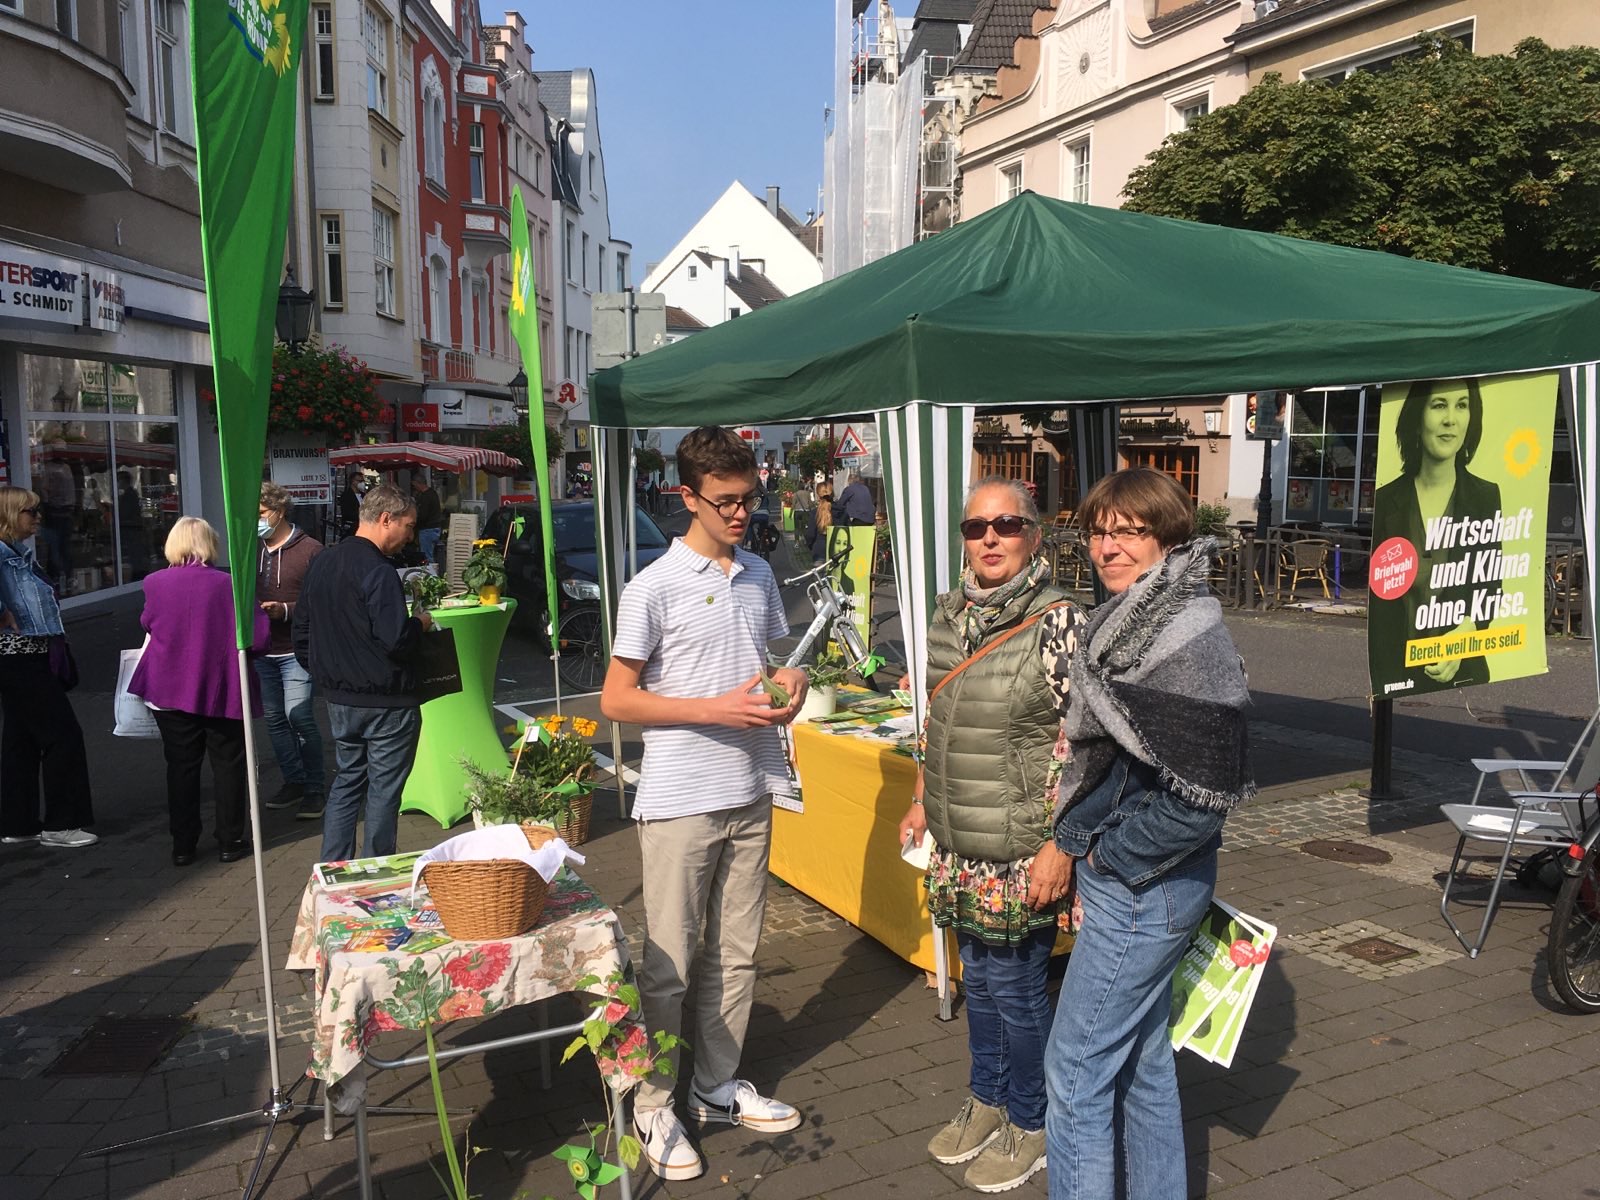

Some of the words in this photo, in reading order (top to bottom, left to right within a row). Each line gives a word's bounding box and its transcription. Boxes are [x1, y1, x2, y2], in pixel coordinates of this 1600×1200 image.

[13, 291, 73, 313] SCHMIDT
[98, 306, 114, 321] AXEL
[1425, 507, 1534, 551] Wirtschaft
[1374, 556, 1413, 581] Briefwahl
[1430, 556, 1470, 589] und
[1471, 551, 1530, 583] Klima
[1382, 572, 1405, 594] jetzt!
[1415, 599, 1465, 630] ohne
[1471, 588, 1528, 622] Krise.
[1410, 641, 1444, 661] Bereit,
[1446, 637, 1466, 654] weil
[1469, 635, 1482, 652] Ihr
[1485, 637, 1497, 650] es
[1499, 630, 1522, 648] seid.
[1384, 678, 1414, 694] gruene.de
[1184, 948, 1211, 972] weil
[1182, 963, 1221, 1001] Bereit,
